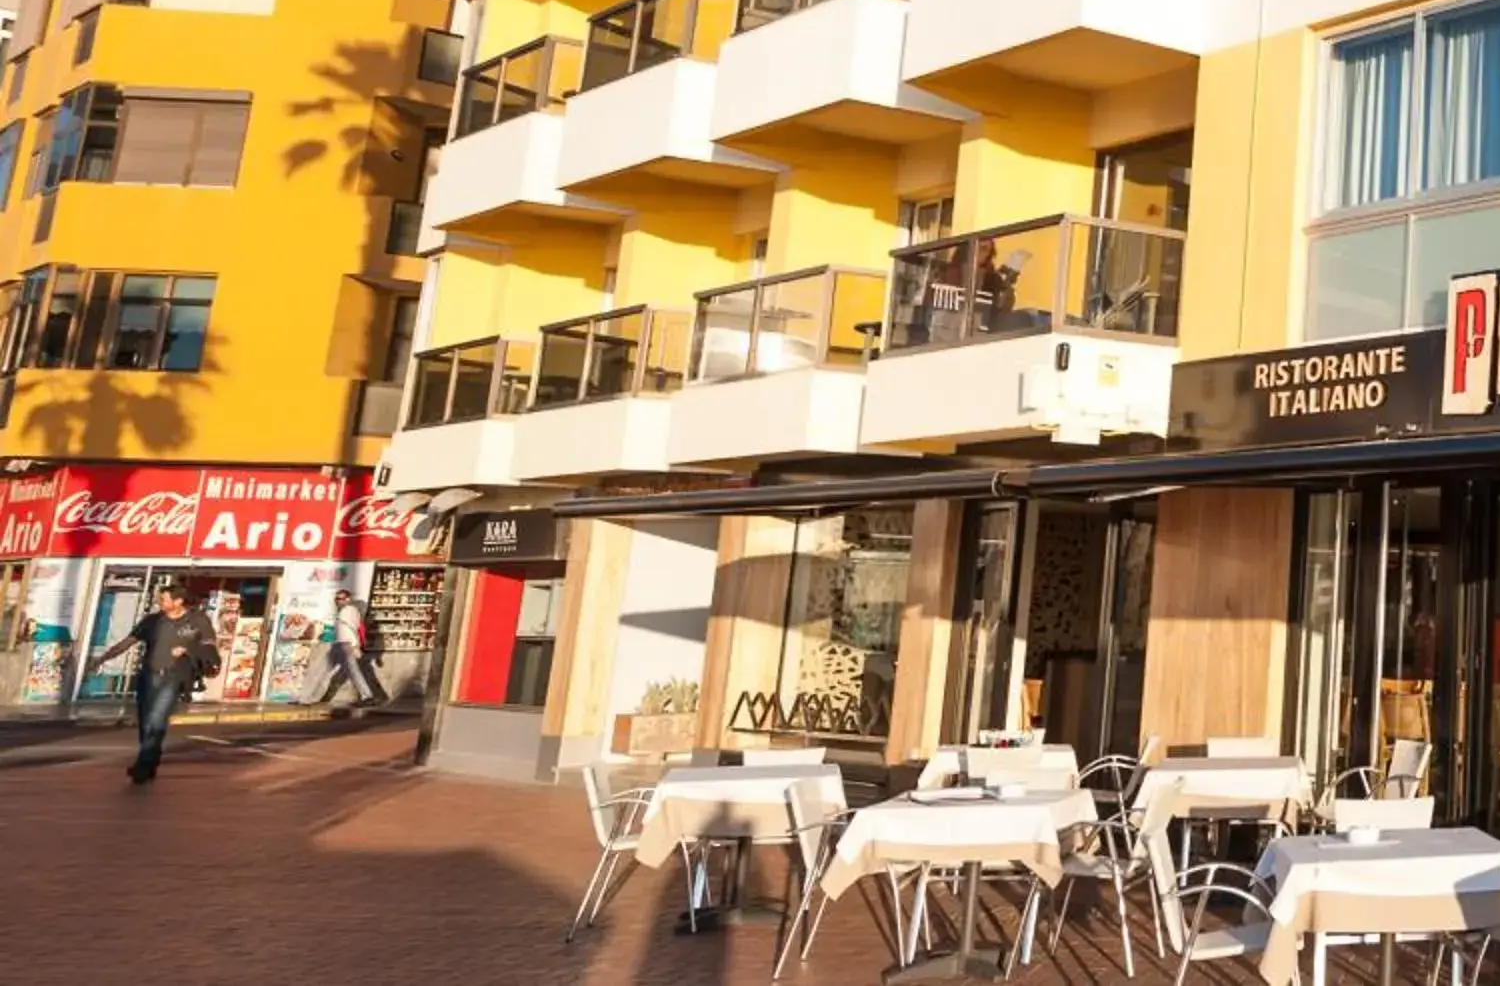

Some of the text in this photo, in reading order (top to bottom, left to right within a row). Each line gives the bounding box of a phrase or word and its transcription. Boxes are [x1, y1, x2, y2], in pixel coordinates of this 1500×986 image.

[1254, 345, 1406, 389] RISTORANTE
[1269, 381, 1385, 418] ITALIANO
[205, 476, 338, 502] Minimarket
[0, 512, 43, 554] Ario
[53, 490, 200, 535] Coca-Cola
[201, 510, 324, 551] Ario
